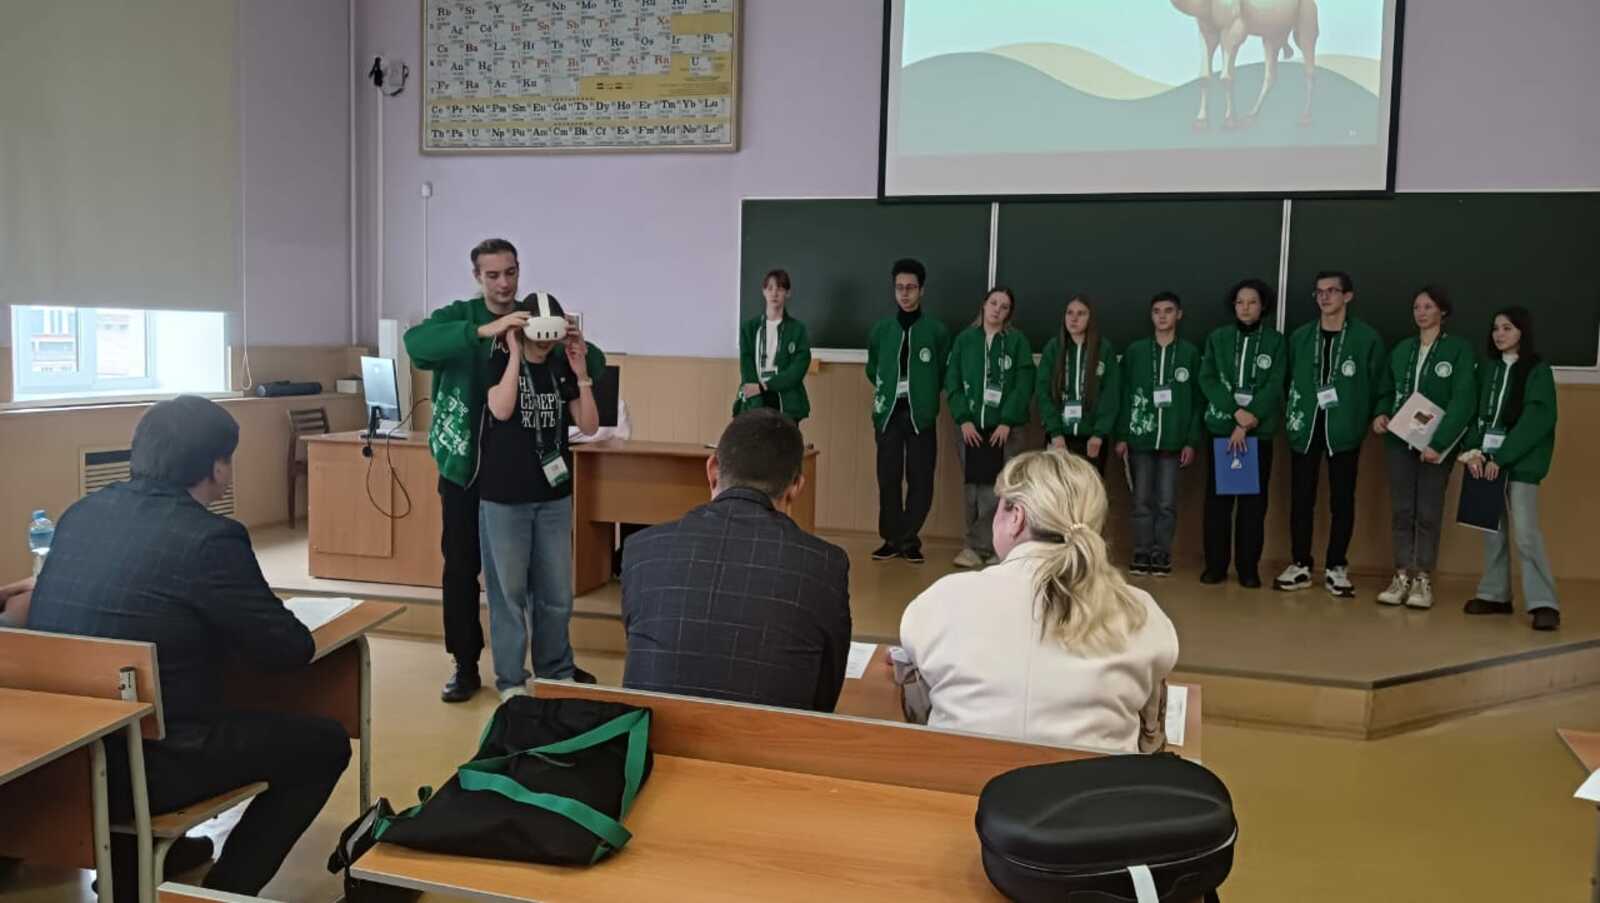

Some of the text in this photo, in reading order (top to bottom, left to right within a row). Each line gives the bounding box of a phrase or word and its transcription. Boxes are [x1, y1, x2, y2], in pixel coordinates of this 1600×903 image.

[494, 4, 500, 13] Y
[552, 2, 566, 10] Nb
[581, 0, 597, 9] Mo
[611, 0, 624, 8] Tc
[480, 24, 492, 33] Cd
[466, 43, 478, 52] Ba
[494, 42, 506, 51] La
[581, 39, 592, 48] W
[611, 38, 624, 47] Re
[641, 36, 654, 46] Os
[672, 35, 680, 45] Ir
[704, 34, 714, 43] Pt
[478, 61, 492, 72] Hg
[692, 56, 700, 66] U
[466, 80, 479, 89] Ra
[523, 79, 537, 88] Ku
[452, 105, 463, 113] Pr
[472, 104, 485, 113] Nd
[492, 104, 507, 112] Pm
[512, 104, 526, 112] Sm
[533, 104, 546, 112] Eu
[553, 103, 566, 111] Gd
[575, 102, 588, 111] Tb
[596, 102, 610, 112] Dy
[617, 101, 630, 111] Ho
[640, 101, 651, 110] Er
[661, 100, 676, 109] Tm
[682, 100, 696, 108] Yb
[432, 130, 444, 138] Th
[472, 129, 480, 137] U
[492, 129, 504, 138] Np
[512, 128, 525, 137] Pu
[553, 128, 568, 136] Cm
[639, 126, 654, 134] Fm
[661, 125, 675, 134] Md
